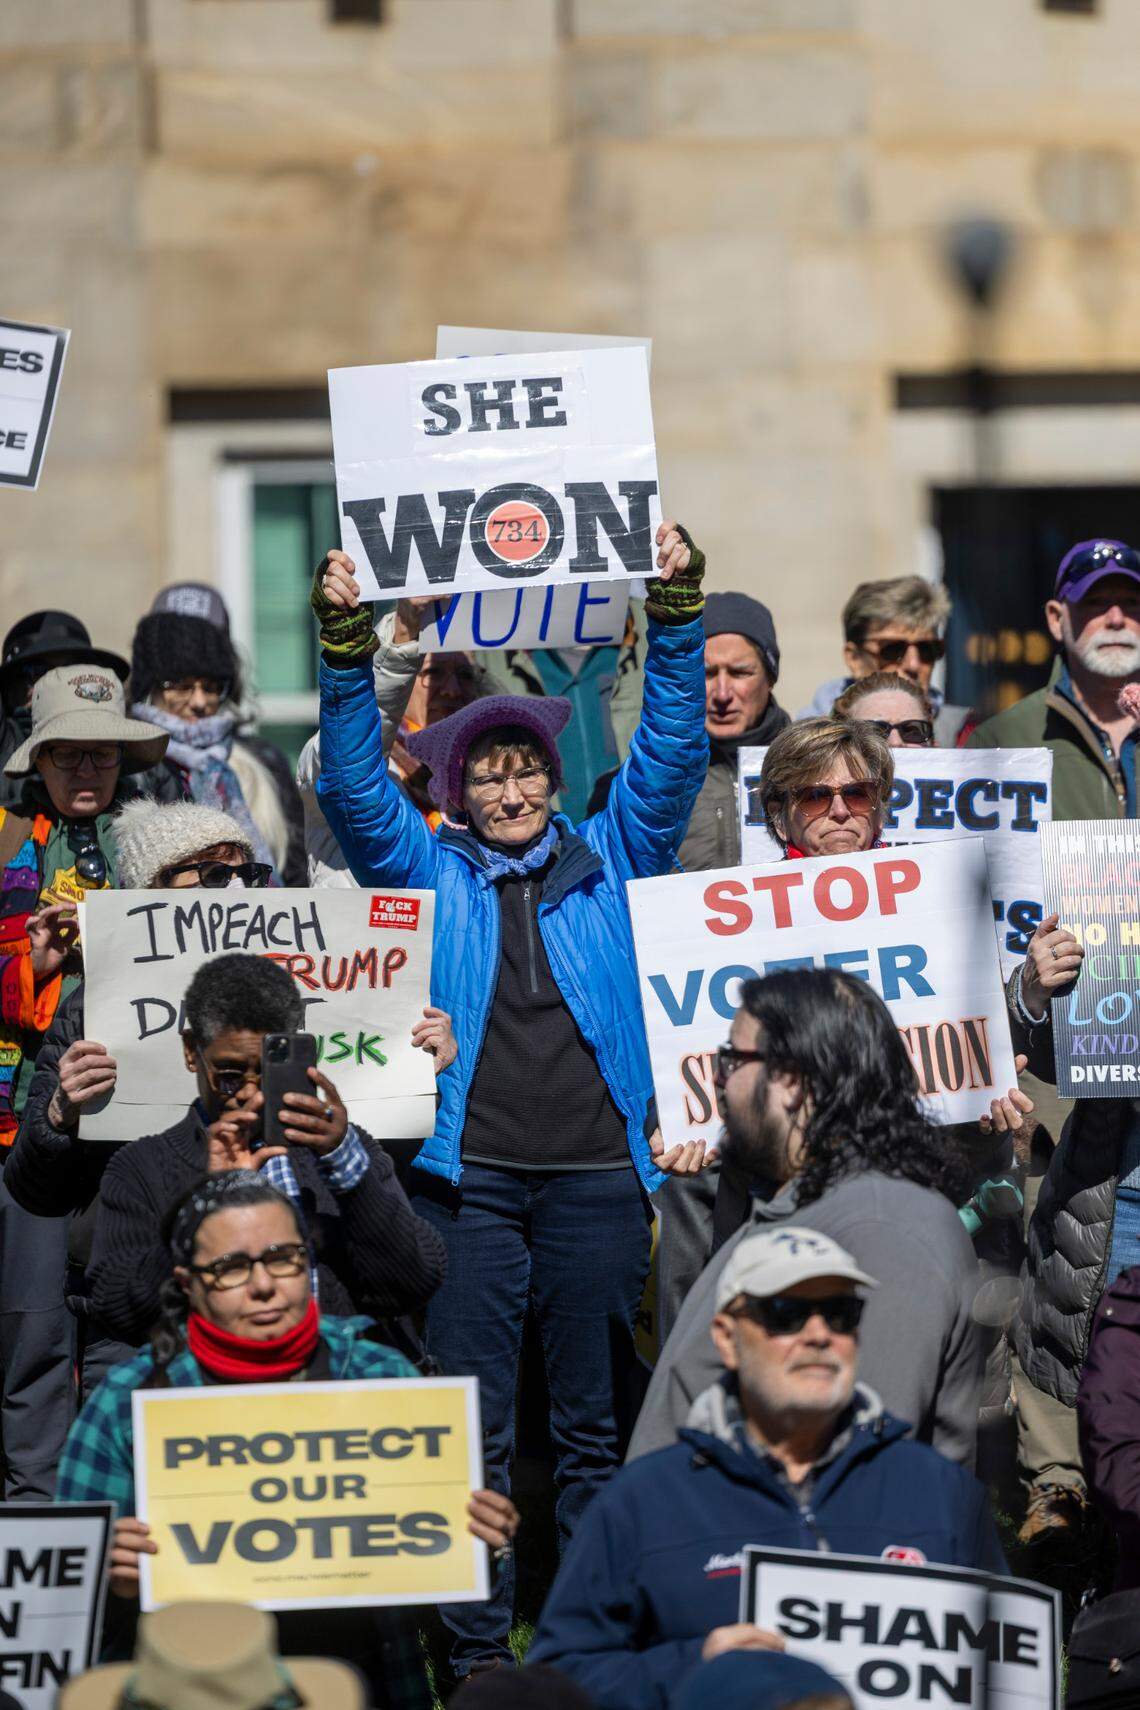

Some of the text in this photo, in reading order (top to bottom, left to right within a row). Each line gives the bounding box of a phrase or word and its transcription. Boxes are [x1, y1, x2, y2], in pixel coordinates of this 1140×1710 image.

[421, 377, 567, 436] SHE
[342, 480, 658, 590] WON
[491, 520, 543, 543] 734
[744, 776, 1048, 833] PECT
[1059, 833, 1140, 854] IN THI
[372, 911, 417, 923] TRUMP
[378, 899, 412, 912] FCK
[703, 859, 921, 936] STOP
[1060, 894, 1137, 915] WOMEN
[126, 900, 327, 963] IMPEACH
[1078, 953, 1140, 981] CI
[1068, 989, 1140, 1025] LO
[1071, 1064, 1140, 1083] DIVER
[163, 1426, 451, 1469] PROTECT
[250, 1474, 367, 1503] OUR
[169, 1512, 452, 1565] VOTES
[0, 1547, 87, 1588] ME
[777, 1597, 1039, 1668] SHAME
[857, 1659, 972, 1705] ON
